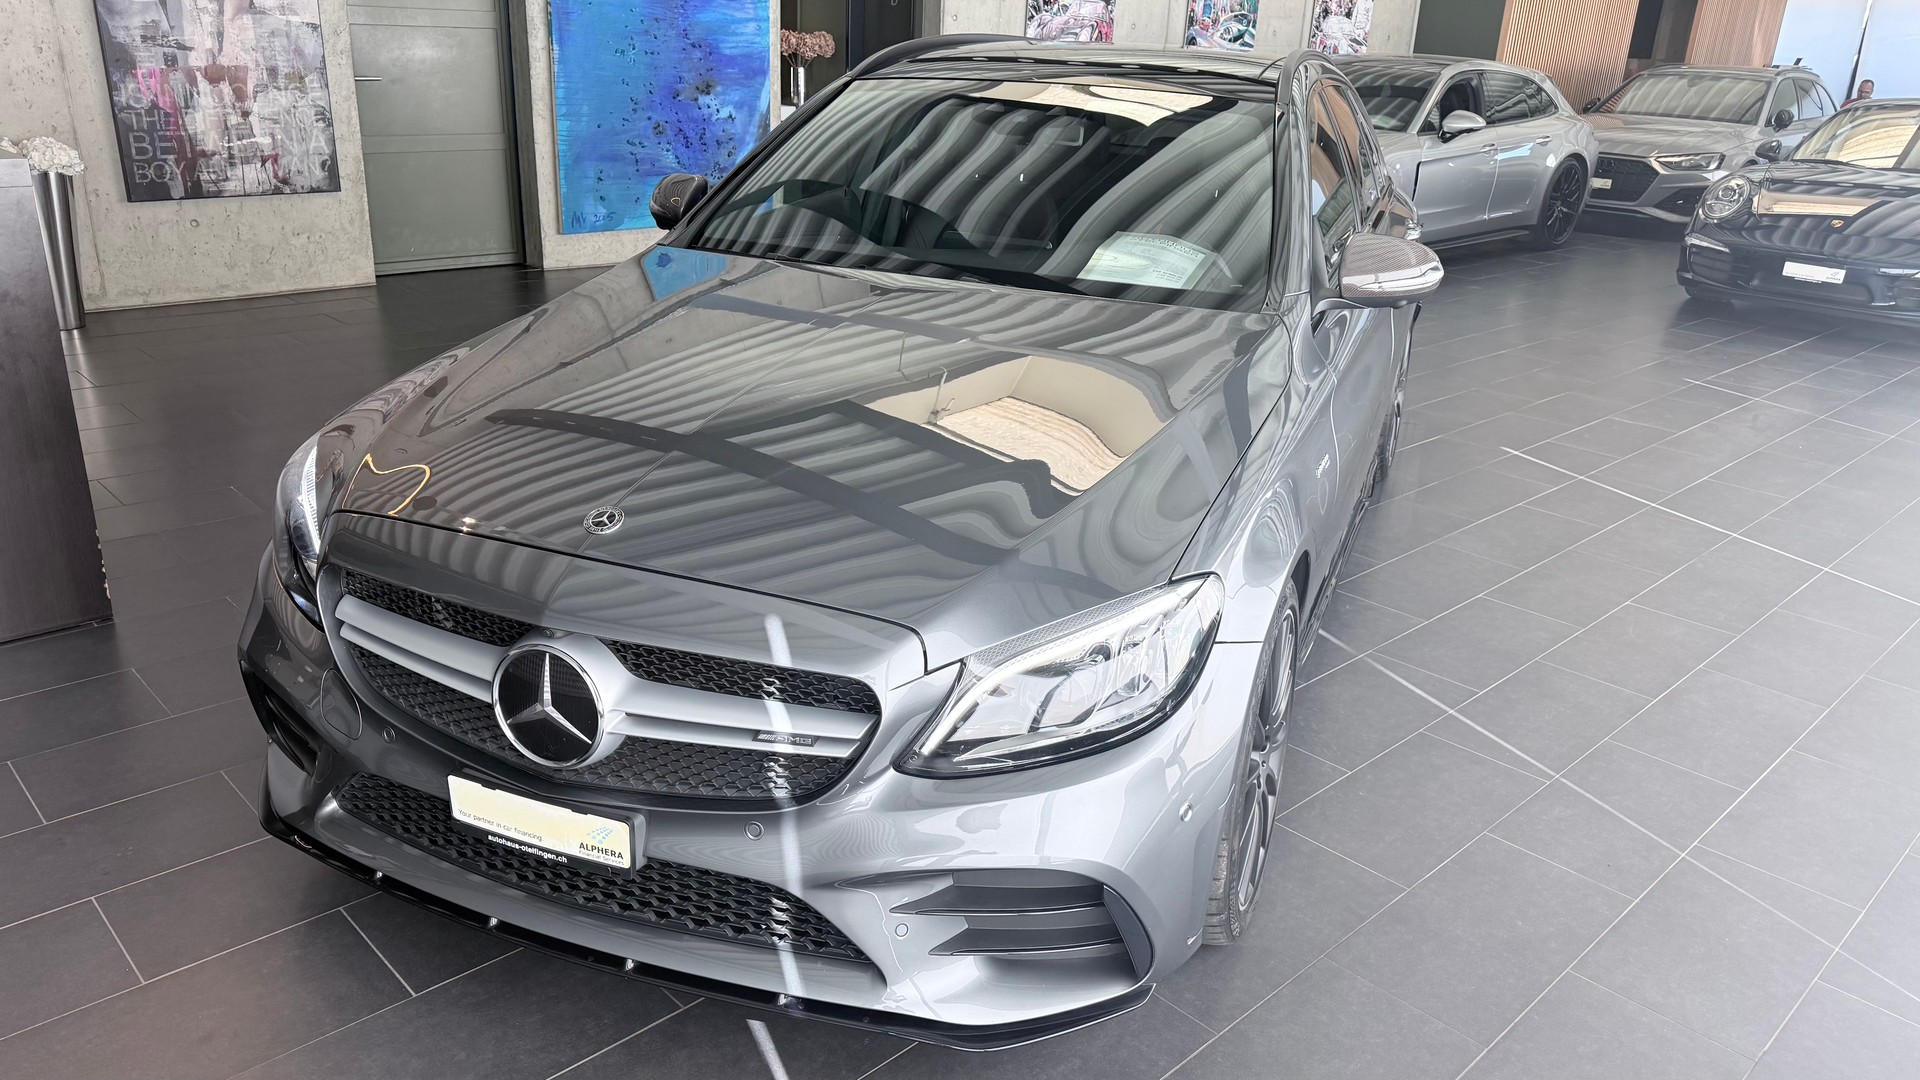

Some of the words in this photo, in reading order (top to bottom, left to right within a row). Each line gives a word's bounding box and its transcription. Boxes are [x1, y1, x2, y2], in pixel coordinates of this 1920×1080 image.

[124, 109, 177, 130] THE
[309, 129, 330, 154] A
[133, 161, 186, 184] BOY
[458, 808, 471, 818] Your
[473, 814, 495, 826] partner
[503, 824, 513, 832] car
[578, 850, 602, 860] Financial
[602, 855, 625, 866] Services
[579, 842, 624, 860] ALPHERA
